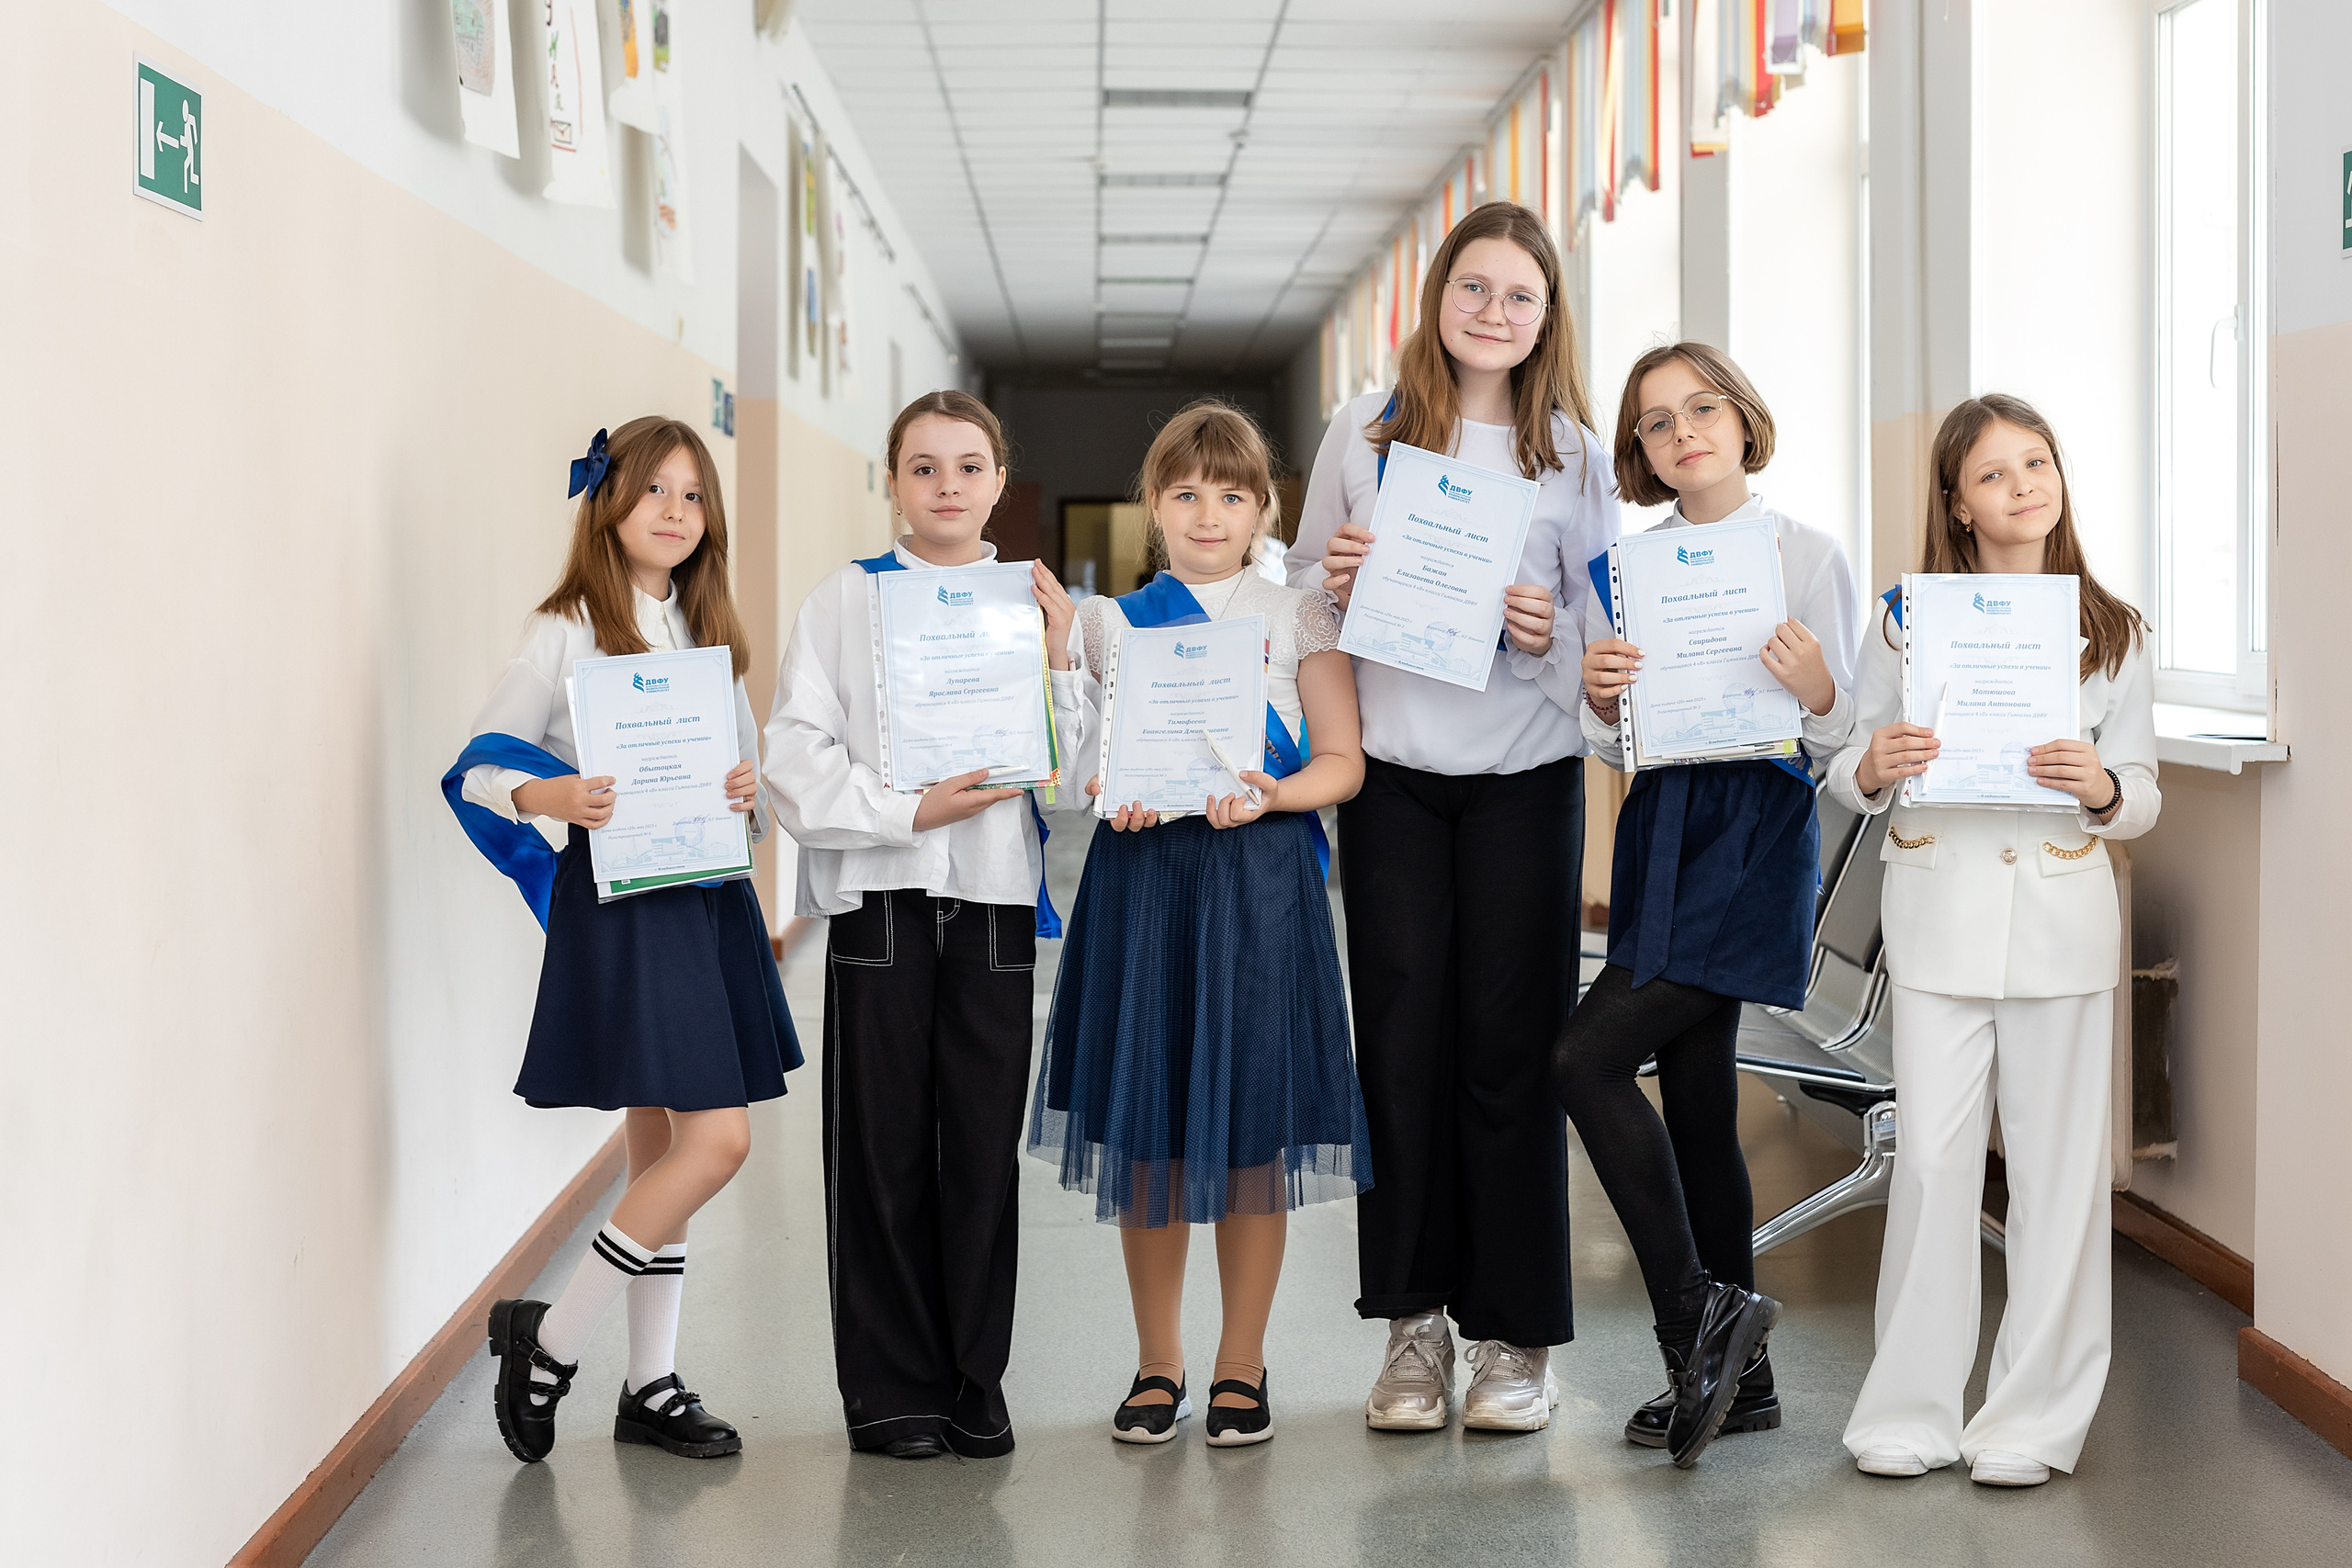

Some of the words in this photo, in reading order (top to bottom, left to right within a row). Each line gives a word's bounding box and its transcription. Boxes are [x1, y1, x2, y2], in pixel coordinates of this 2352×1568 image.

[1450, 485, 1473, 496] ДВФУ
[1408, 513, 1461, 535] Похвальный
[1464, 533, 1488, 543] лист
[1412, 538, 1443, 550] отличные
[1443, 547, 1464, 556] успехи
[1467, 554, 1492, 563] учении»
[1690, 549, 1713, 558] ДВФУ
[1422, 565, 1447, 577] Бажан
[1396, 569, 1434, 584] Елизавета
[1435, 581, 1467, 594] Олеговна
[1661, 590, 1718, 604] Похвальный
[1723, 588, 1747, 596] лист
[1674, 614, 1707, 622] отличные
[920, 631, 975, 642] Похвальный
[1689, 637, 1727, 646] Свиридова
[1951, 641, 2010, 649] Похвальный
[1706, 646, 1742, 656] Сергеевна
[946, 677, 979, 685] Лупарева
[1151, 680, 1204, 688] Похвальный
[1208, 677, 1231, 685] лист
[929, 690, 962, 698] Ярослава
[963, 687, 999, 695] Сергеевна
[616, 717, 672, 729] Похвальный
[1183, 727, 1229, 735] Дмитиевна
[660, 774, 691, 783] Юрьевна
